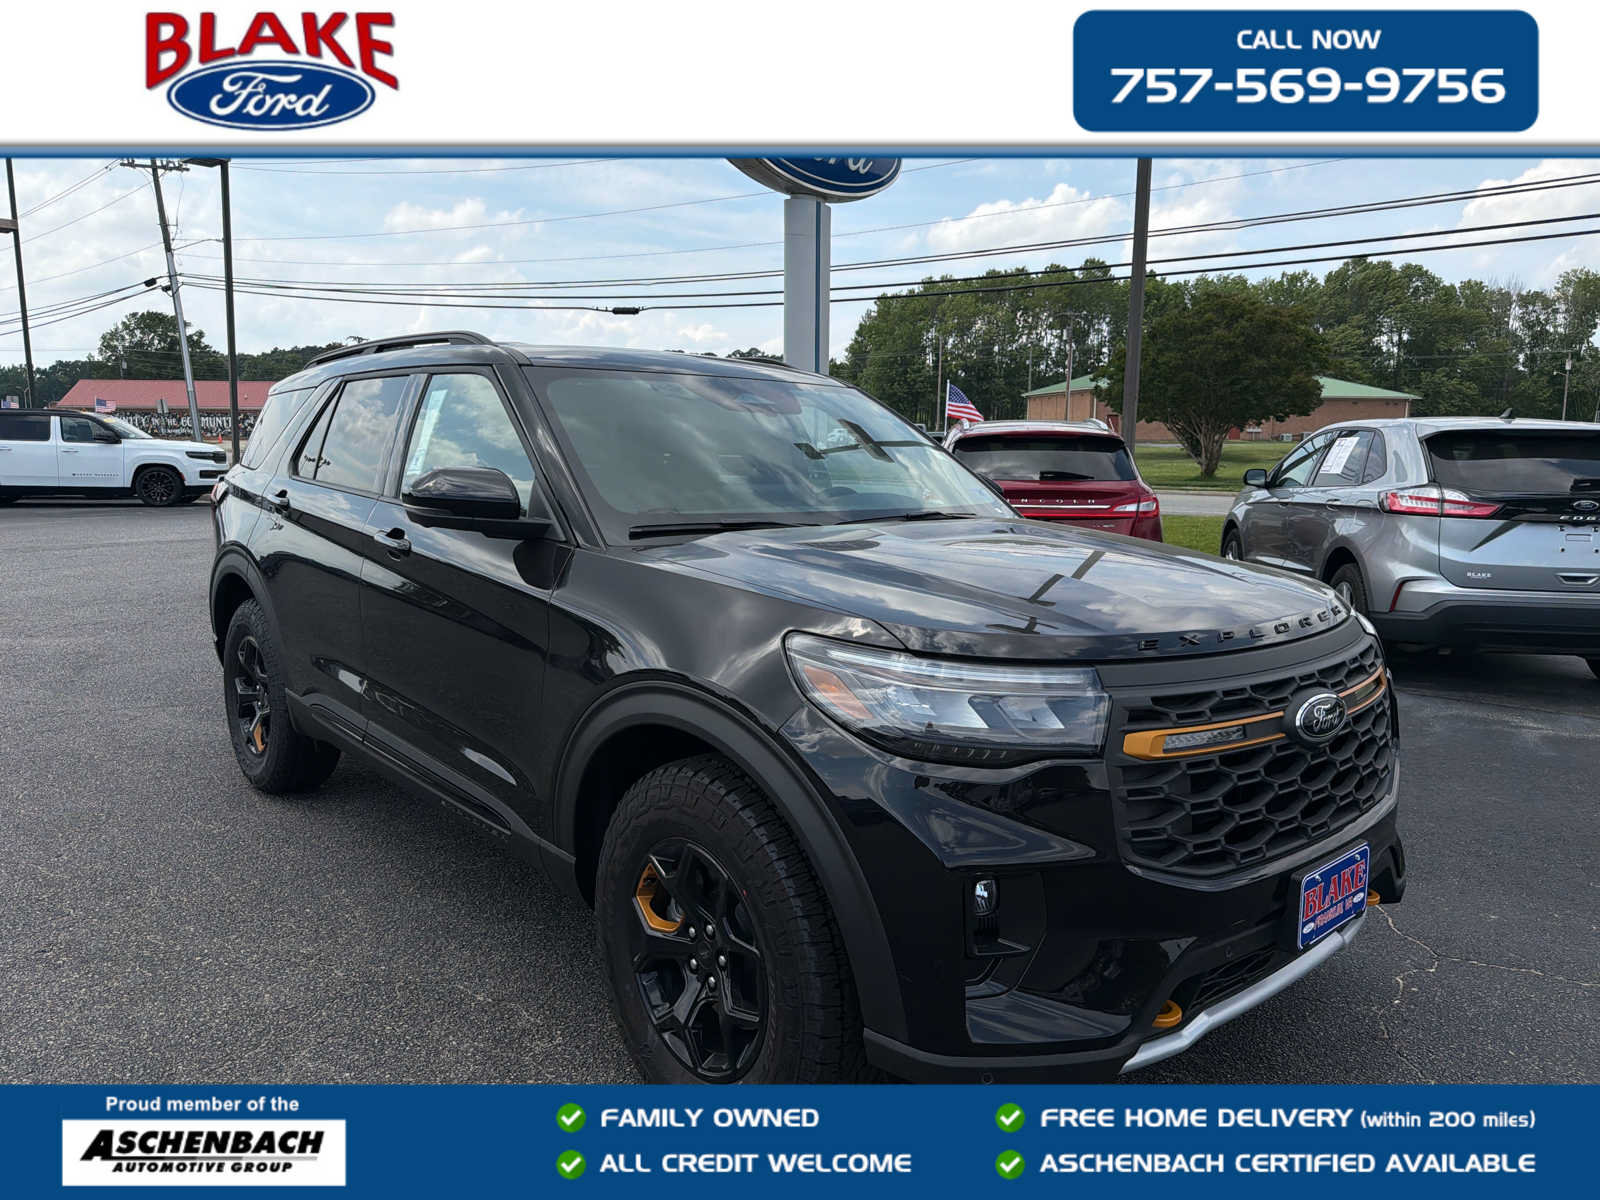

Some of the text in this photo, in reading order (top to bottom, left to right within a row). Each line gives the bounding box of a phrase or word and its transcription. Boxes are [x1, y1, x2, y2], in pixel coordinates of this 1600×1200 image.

[1138, 605, 1342, 651] EXPLORER
[1312, 704, 1341, 731] Ford
[1303, 860, 1366, 921] BLAKE
